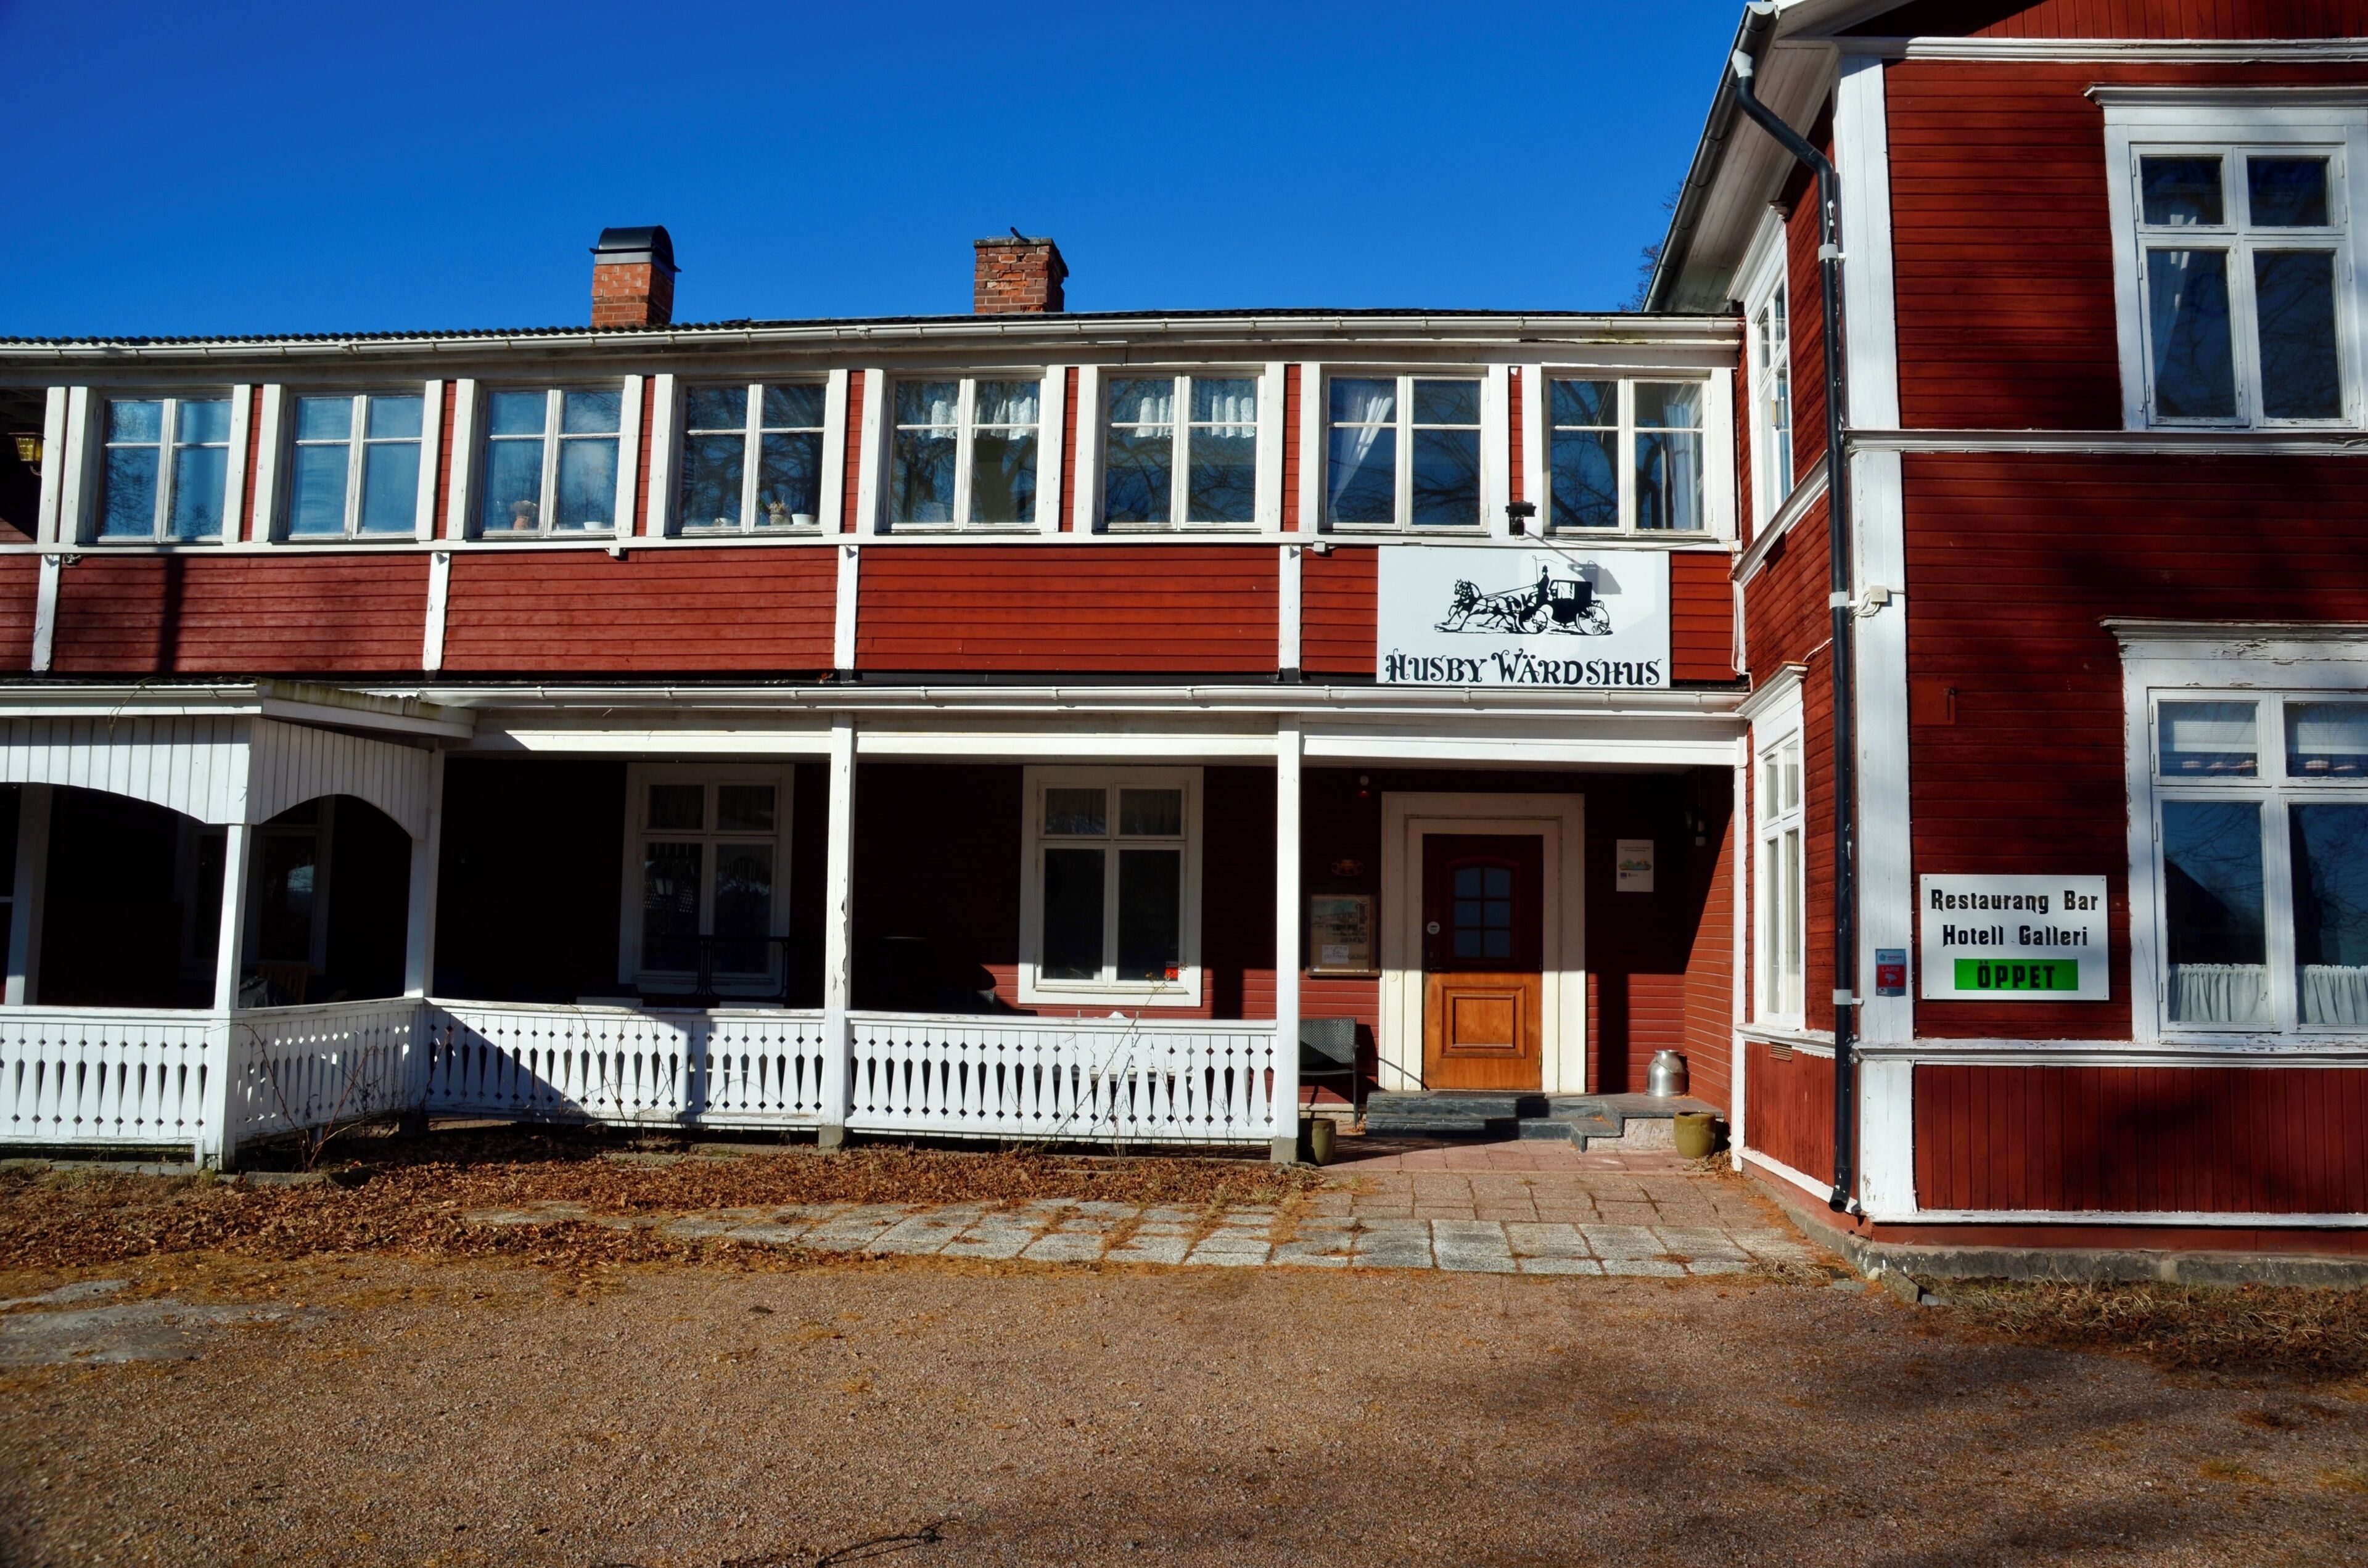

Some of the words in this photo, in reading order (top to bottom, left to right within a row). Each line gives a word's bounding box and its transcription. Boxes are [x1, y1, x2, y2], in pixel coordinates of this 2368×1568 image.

[1385, 648, 1487, 683] HUSBY
[1491, 648, 1662, 685] WÄRDSHUS
[1931, 889, 2049, 914] Restaurang
[2064, 890, 2098, 910] Bar
[1942, 924, 2004, 947] Hotell
[2019, 925, 2087, 946] Galleri
[1977, 961, 2055, 989] ÖPPET
